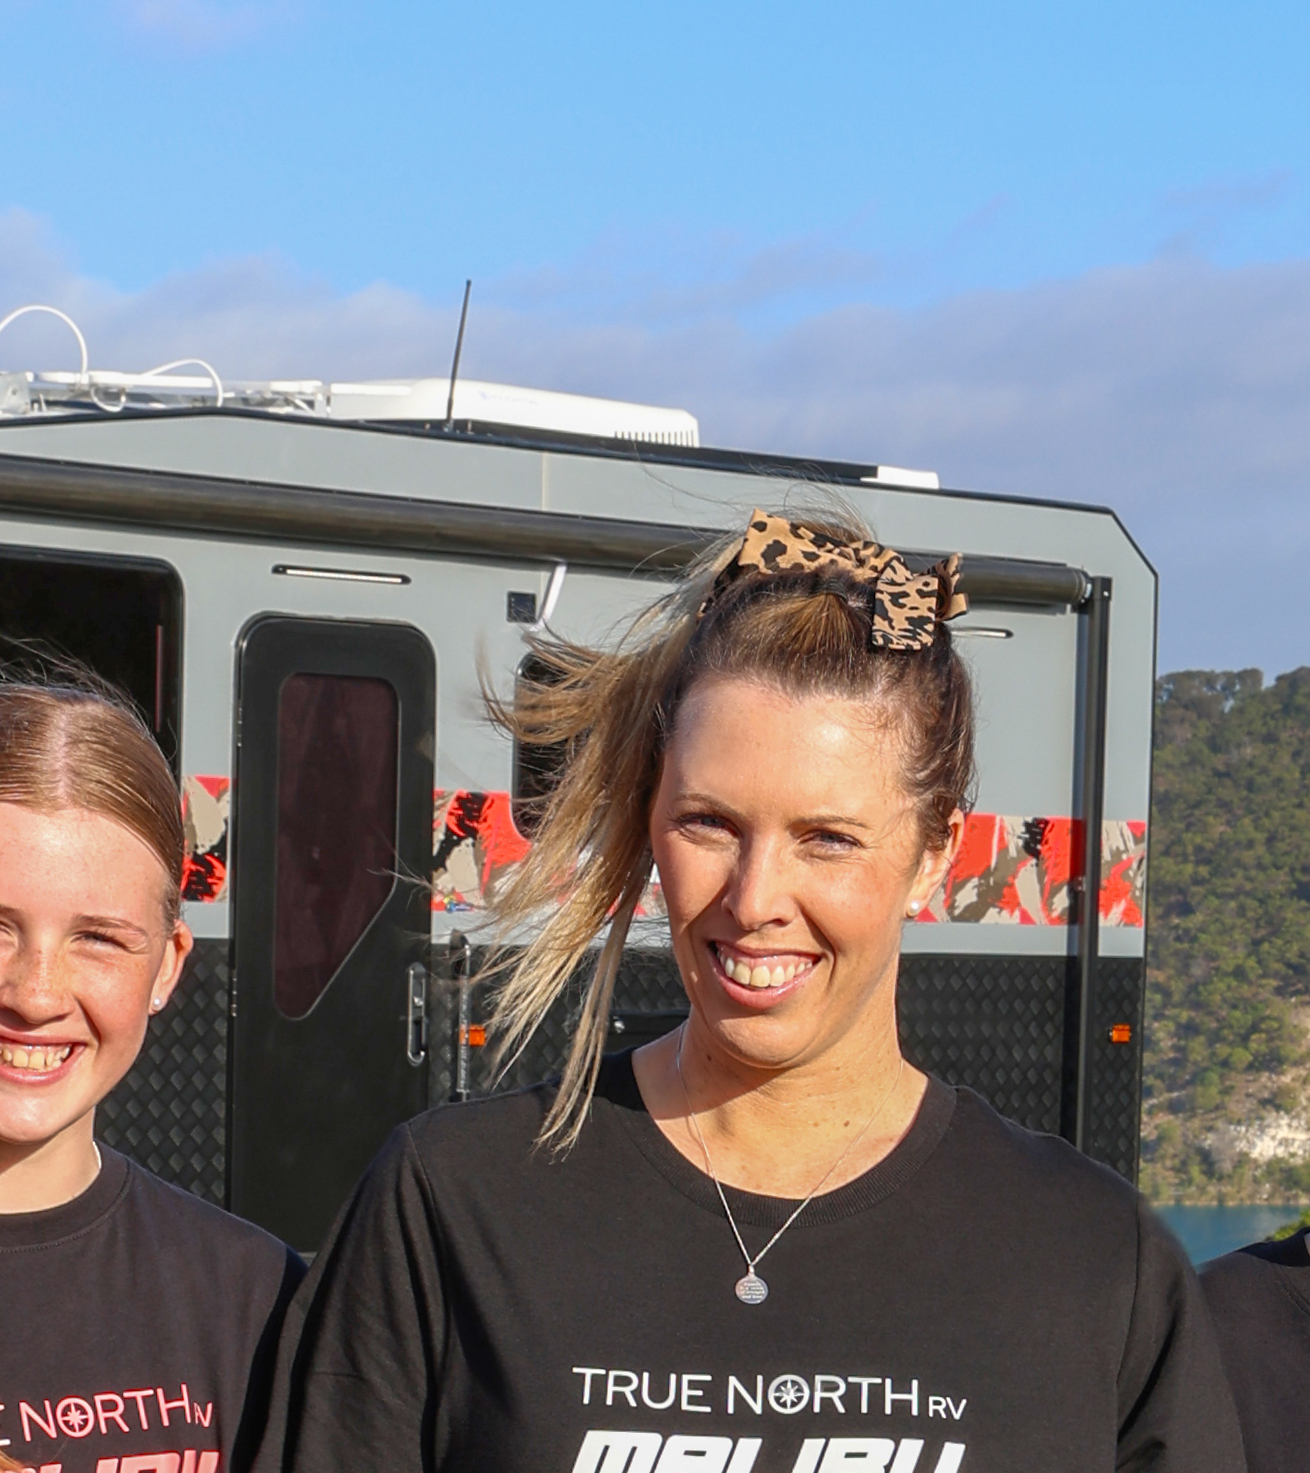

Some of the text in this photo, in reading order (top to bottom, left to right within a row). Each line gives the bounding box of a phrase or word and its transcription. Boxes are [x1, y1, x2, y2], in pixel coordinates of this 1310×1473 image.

[18, 1382, 192, 1442] NORTH
[572, 1366, 968, 1420] TRUE NORTH RV
